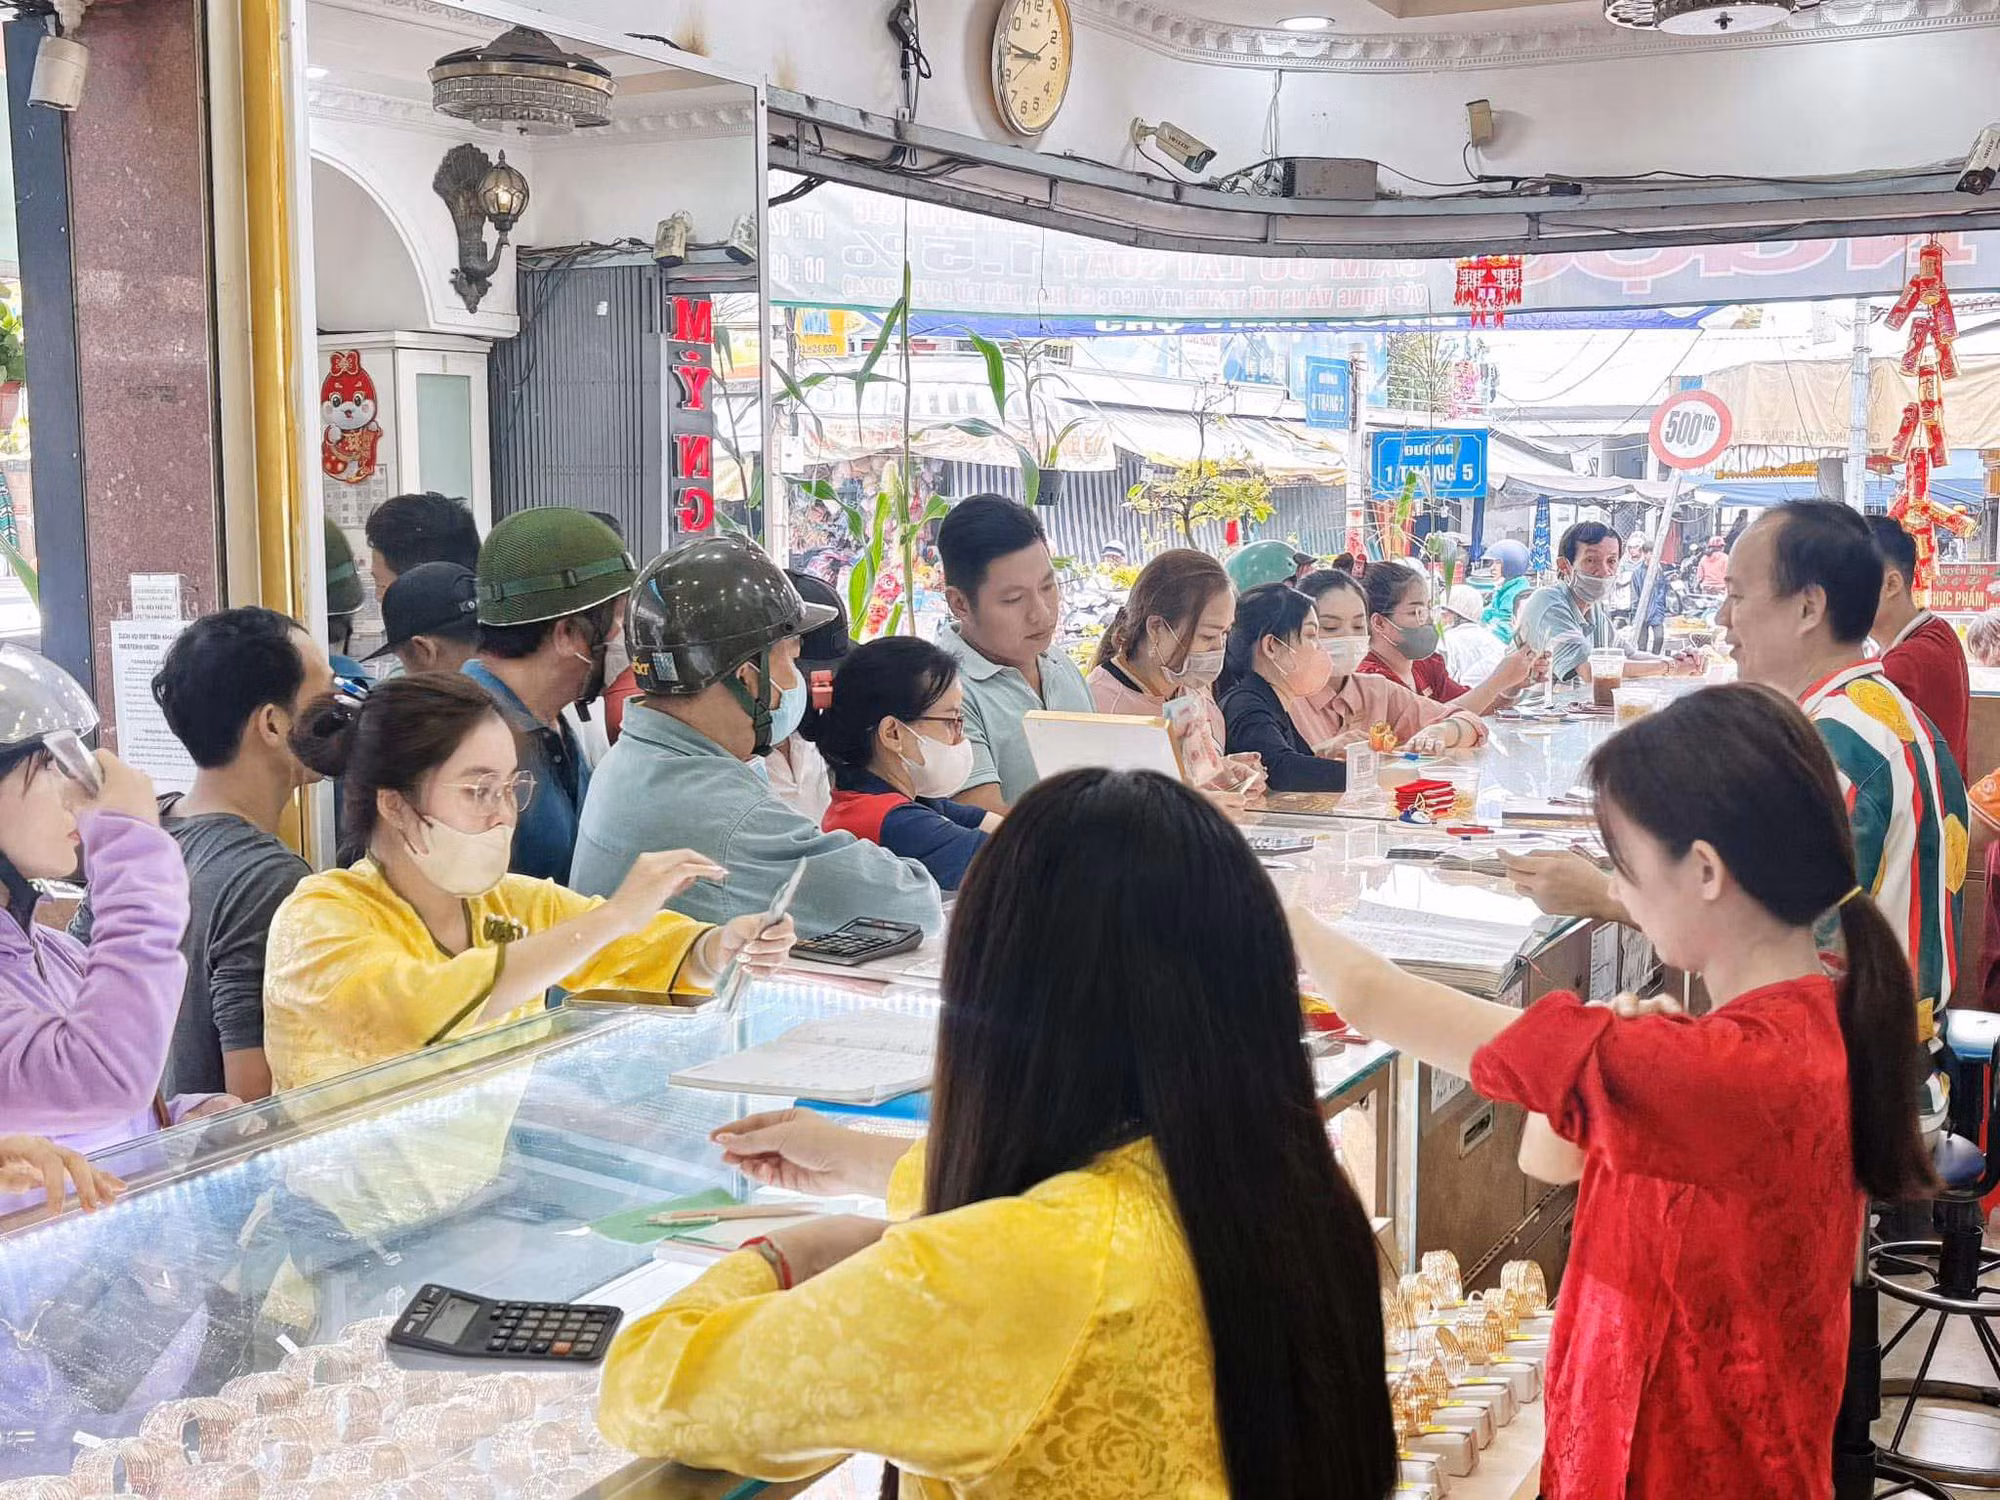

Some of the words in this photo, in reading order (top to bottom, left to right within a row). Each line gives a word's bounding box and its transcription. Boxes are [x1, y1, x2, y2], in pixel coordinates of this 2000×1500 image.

[1013, 17, 1021, 31] 0
[1050, 30, 1057, 45] 2
[1050, 57, 1057, 71] 3
[1043, 81, 1050, 95] 4
[1010, 90, 1018, 104] 7
[1032, 97, 1040, 111] 5
[1020, 100, 1028, 115] 6
[1665, 410, 1702, 445] 500
[1702, 414, 1717, 432] KG
[1385, 465, 1393, 483] 1
[1399, 460, 1455, 483] THÁNG
[1462, 463, 1474, 480] 5
[1932, 589, 1953, 609] HỰC
[1955, 585, 1985, 606] PHẨM
